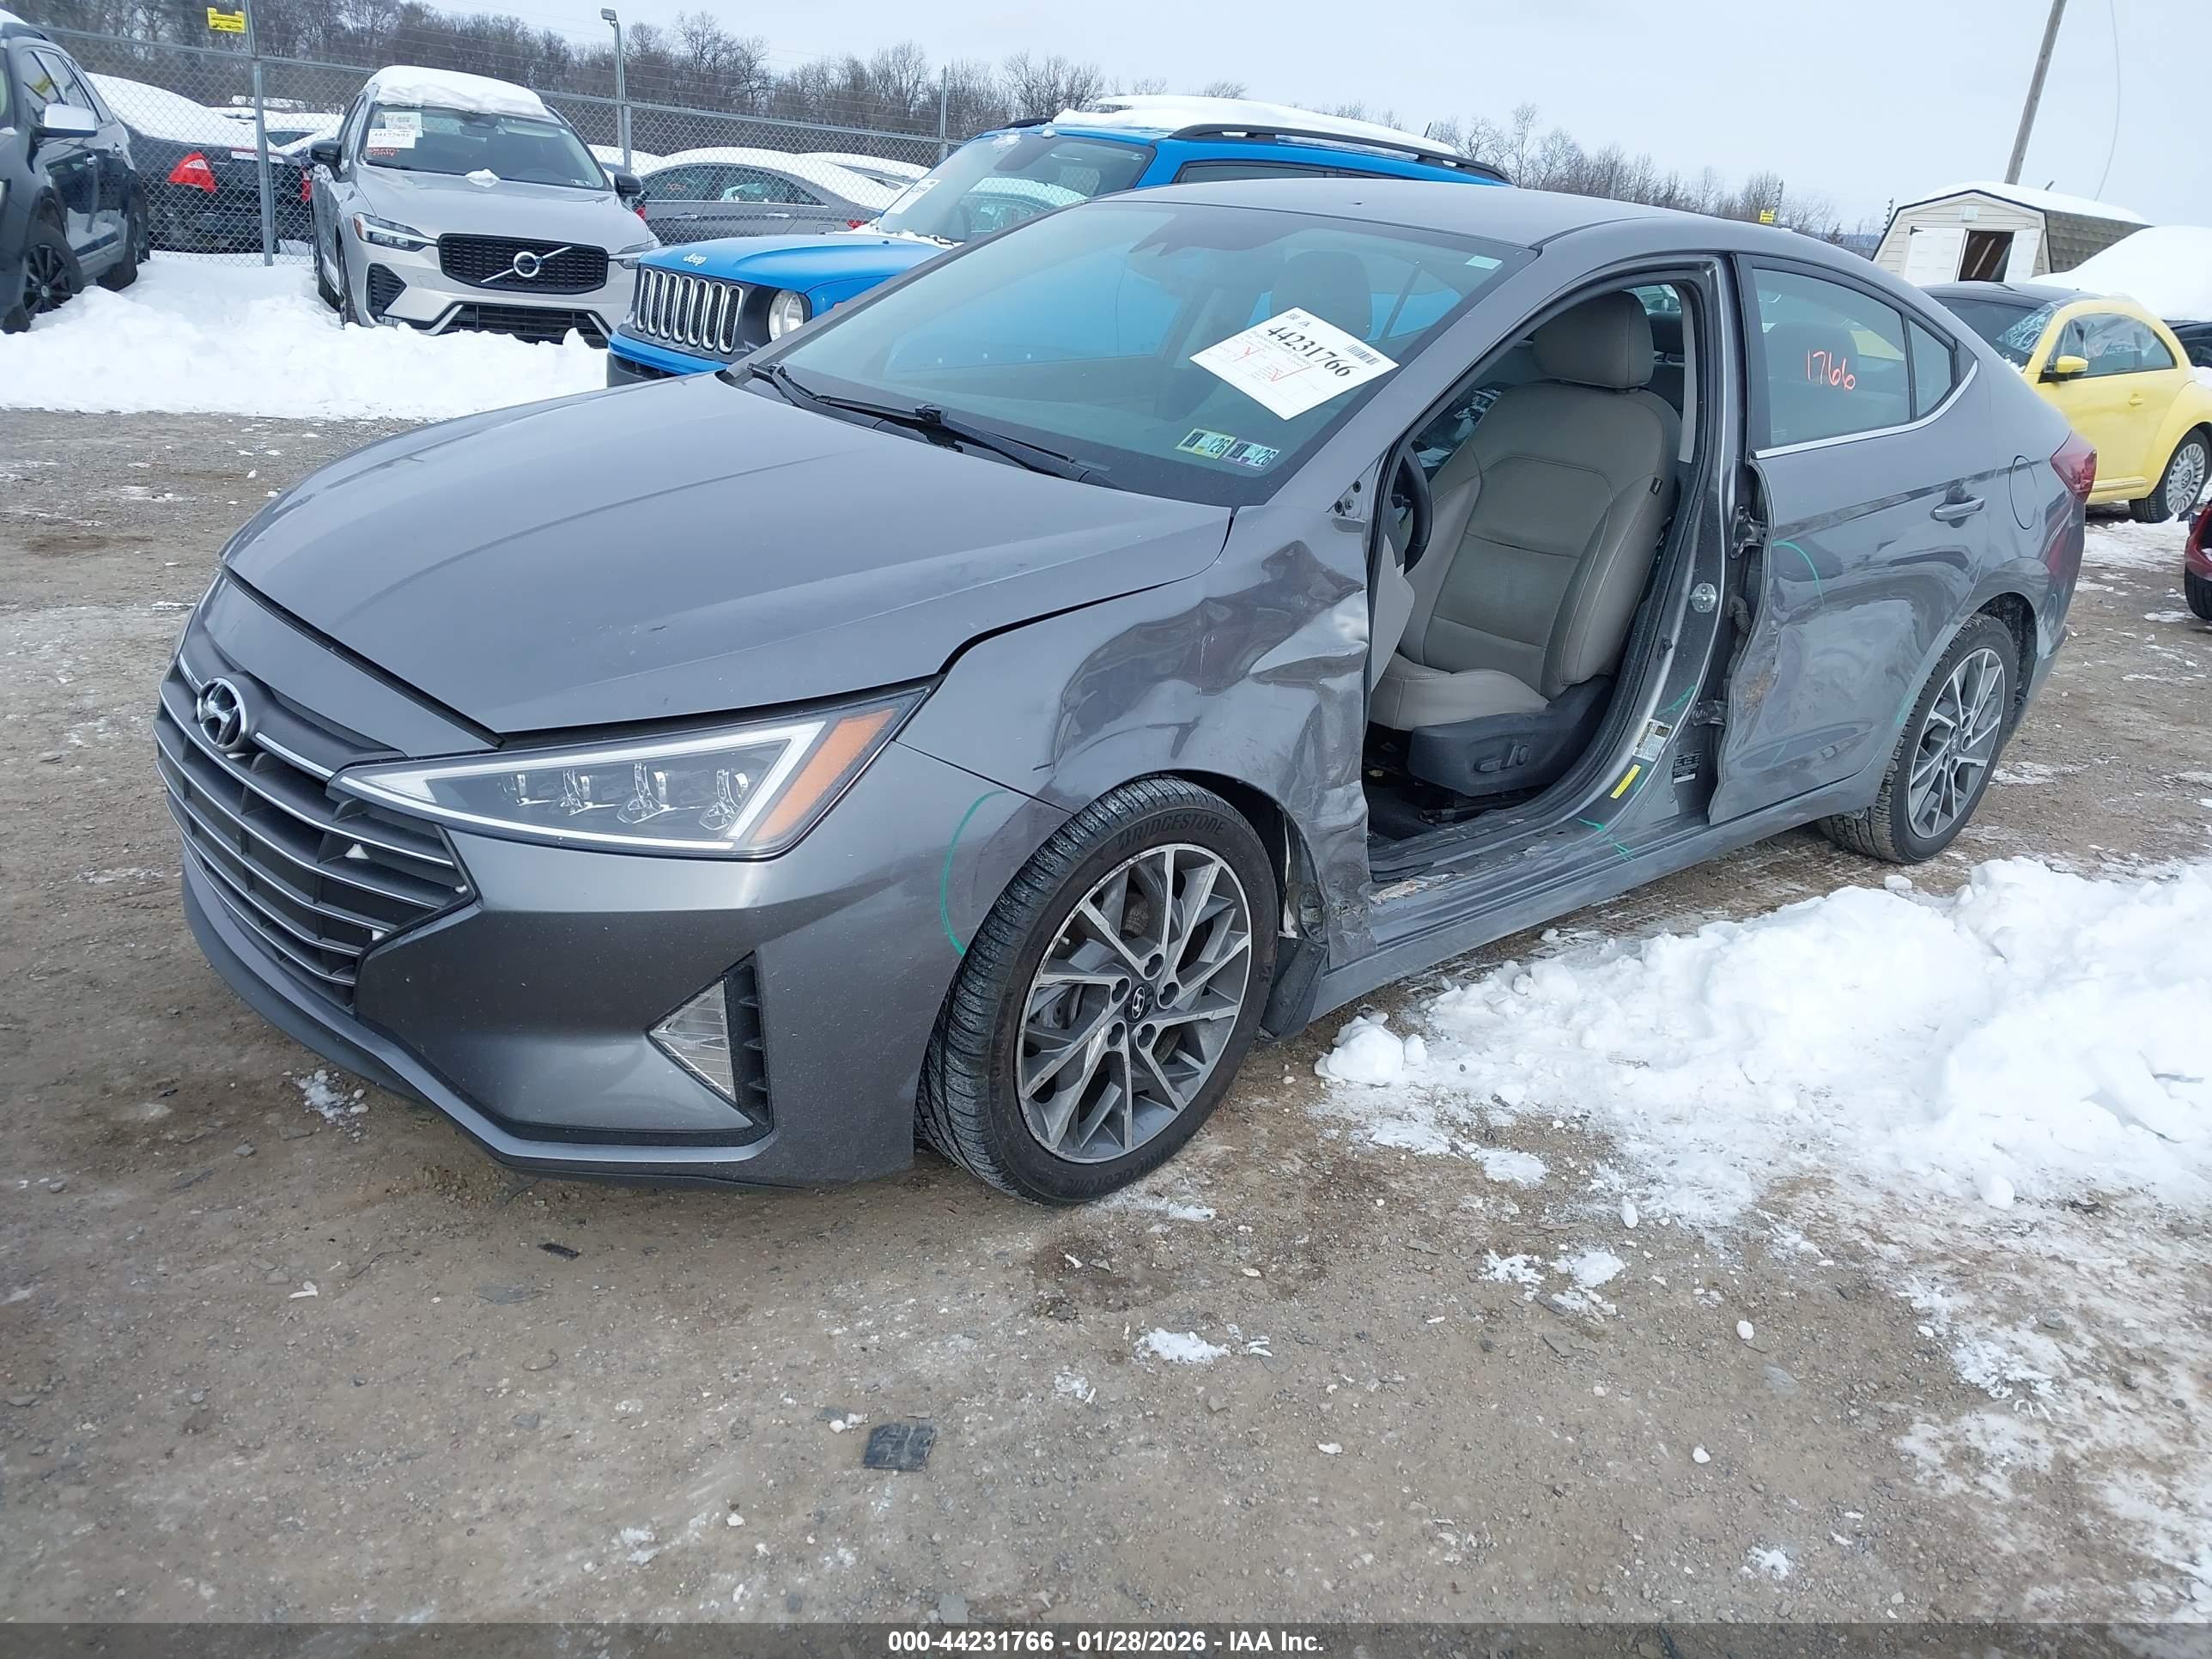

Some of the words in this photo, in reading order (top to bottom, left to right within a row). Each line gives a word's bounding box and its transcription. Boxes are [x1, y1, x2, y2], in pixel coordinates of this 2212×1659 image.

[683, 252, 708, 267] Jeep
[1267, 326, 1359, 377] 44231766
[1805, 349, 1856, 391] 1766
[1209, 438, 1231, 454] 26
[1255, 449, 1276, 466] 26
[1118, 814, 1226, 848] BRIDGESTONE
